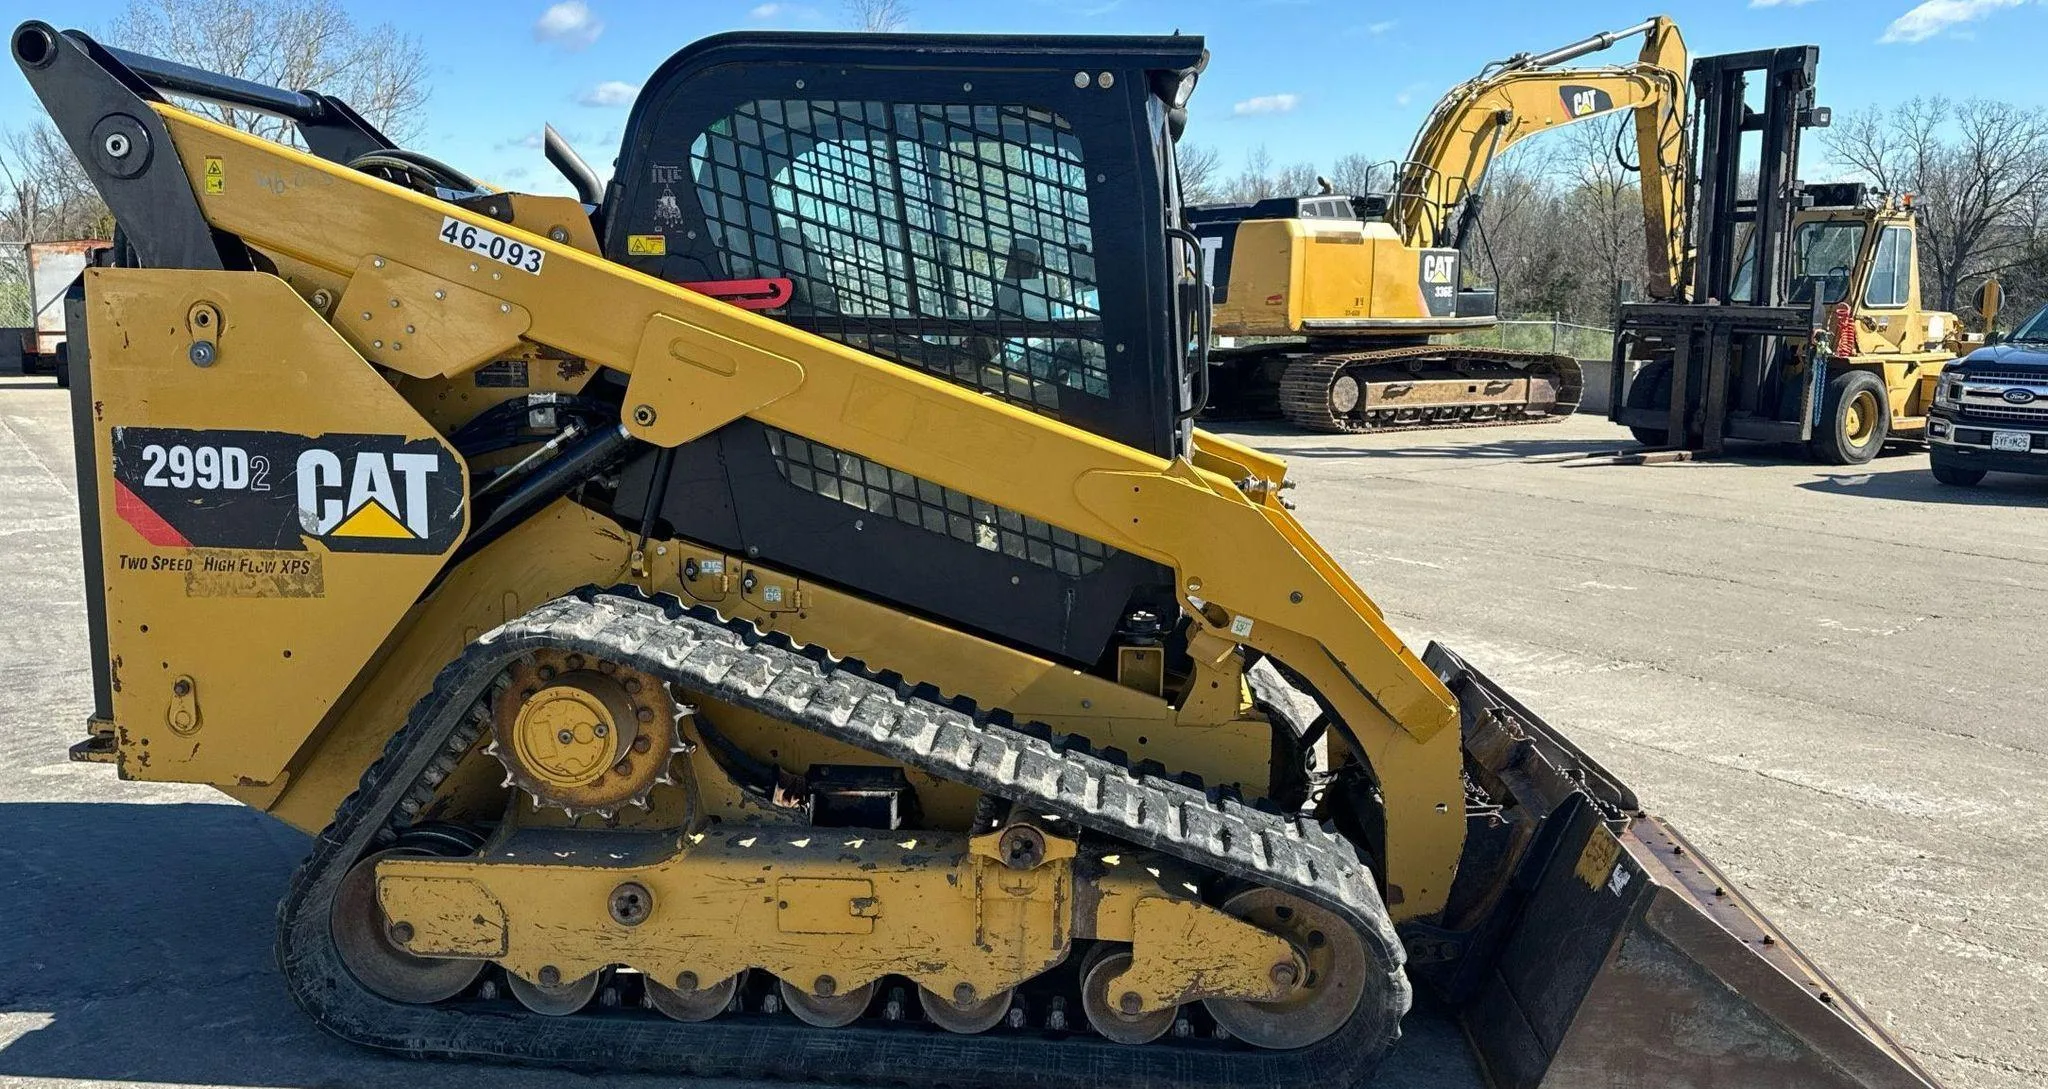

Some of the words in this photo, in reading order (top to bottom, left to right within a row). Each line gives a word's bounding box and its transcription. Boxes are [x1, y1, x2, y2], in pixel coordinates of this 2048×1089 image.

[1573, 89, 1596, 115] CAT
[442, 220, 542, 273] 46-093
[1424, 255, 1454, 283] CAT
[296, 449, 439, 539] CAT
[119, 555, 148, 570] TWO
[151, 555, 193, 571] SPEED
[203, 556, 235, 572] HIGH
[279, 559, 311, 574] XPS
